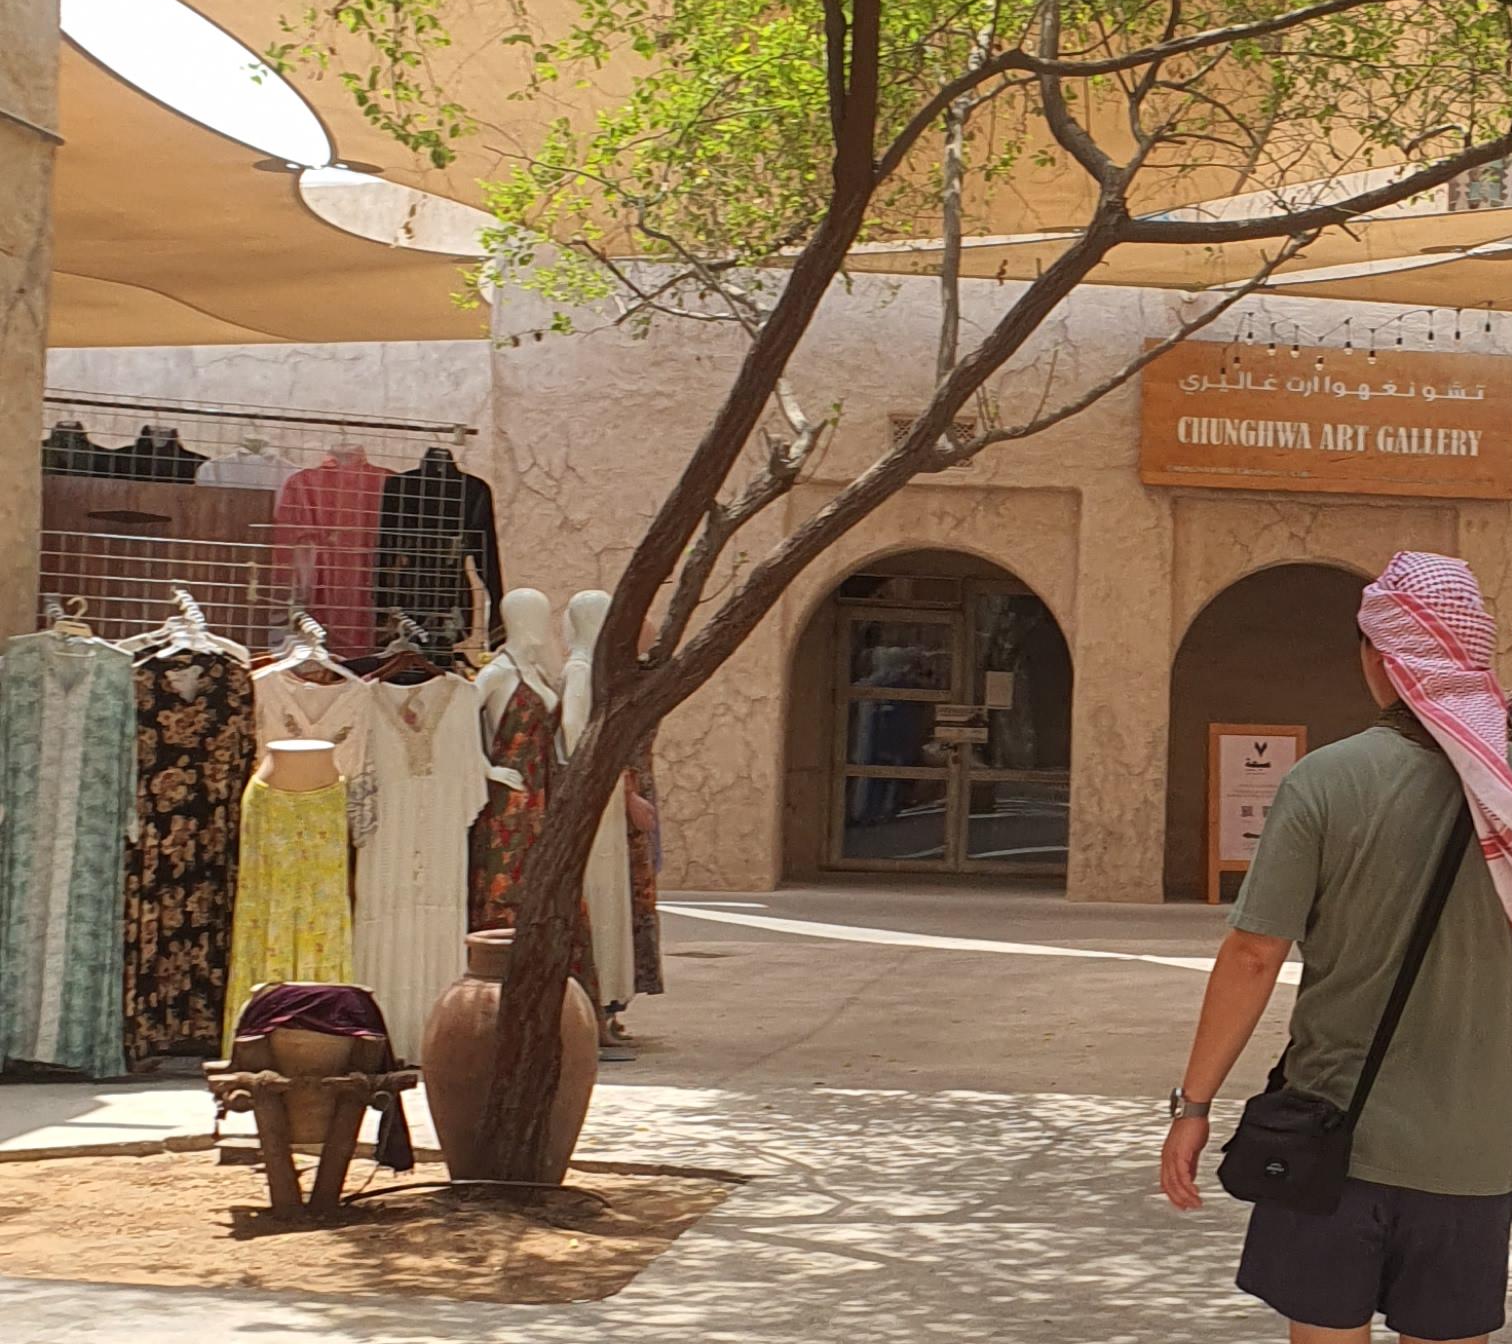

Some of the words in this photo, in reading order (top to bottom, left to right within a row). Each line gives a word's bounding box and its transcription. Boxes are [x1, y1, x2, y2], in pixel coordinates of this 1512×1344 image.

[1179, 371, 1278, 395] غاليري
[1177, 416, 1313, 449] CHUNGHWA
[1319, 423, 1370, 452] ART
[1376, 426, 1483, 457] GALLERY
